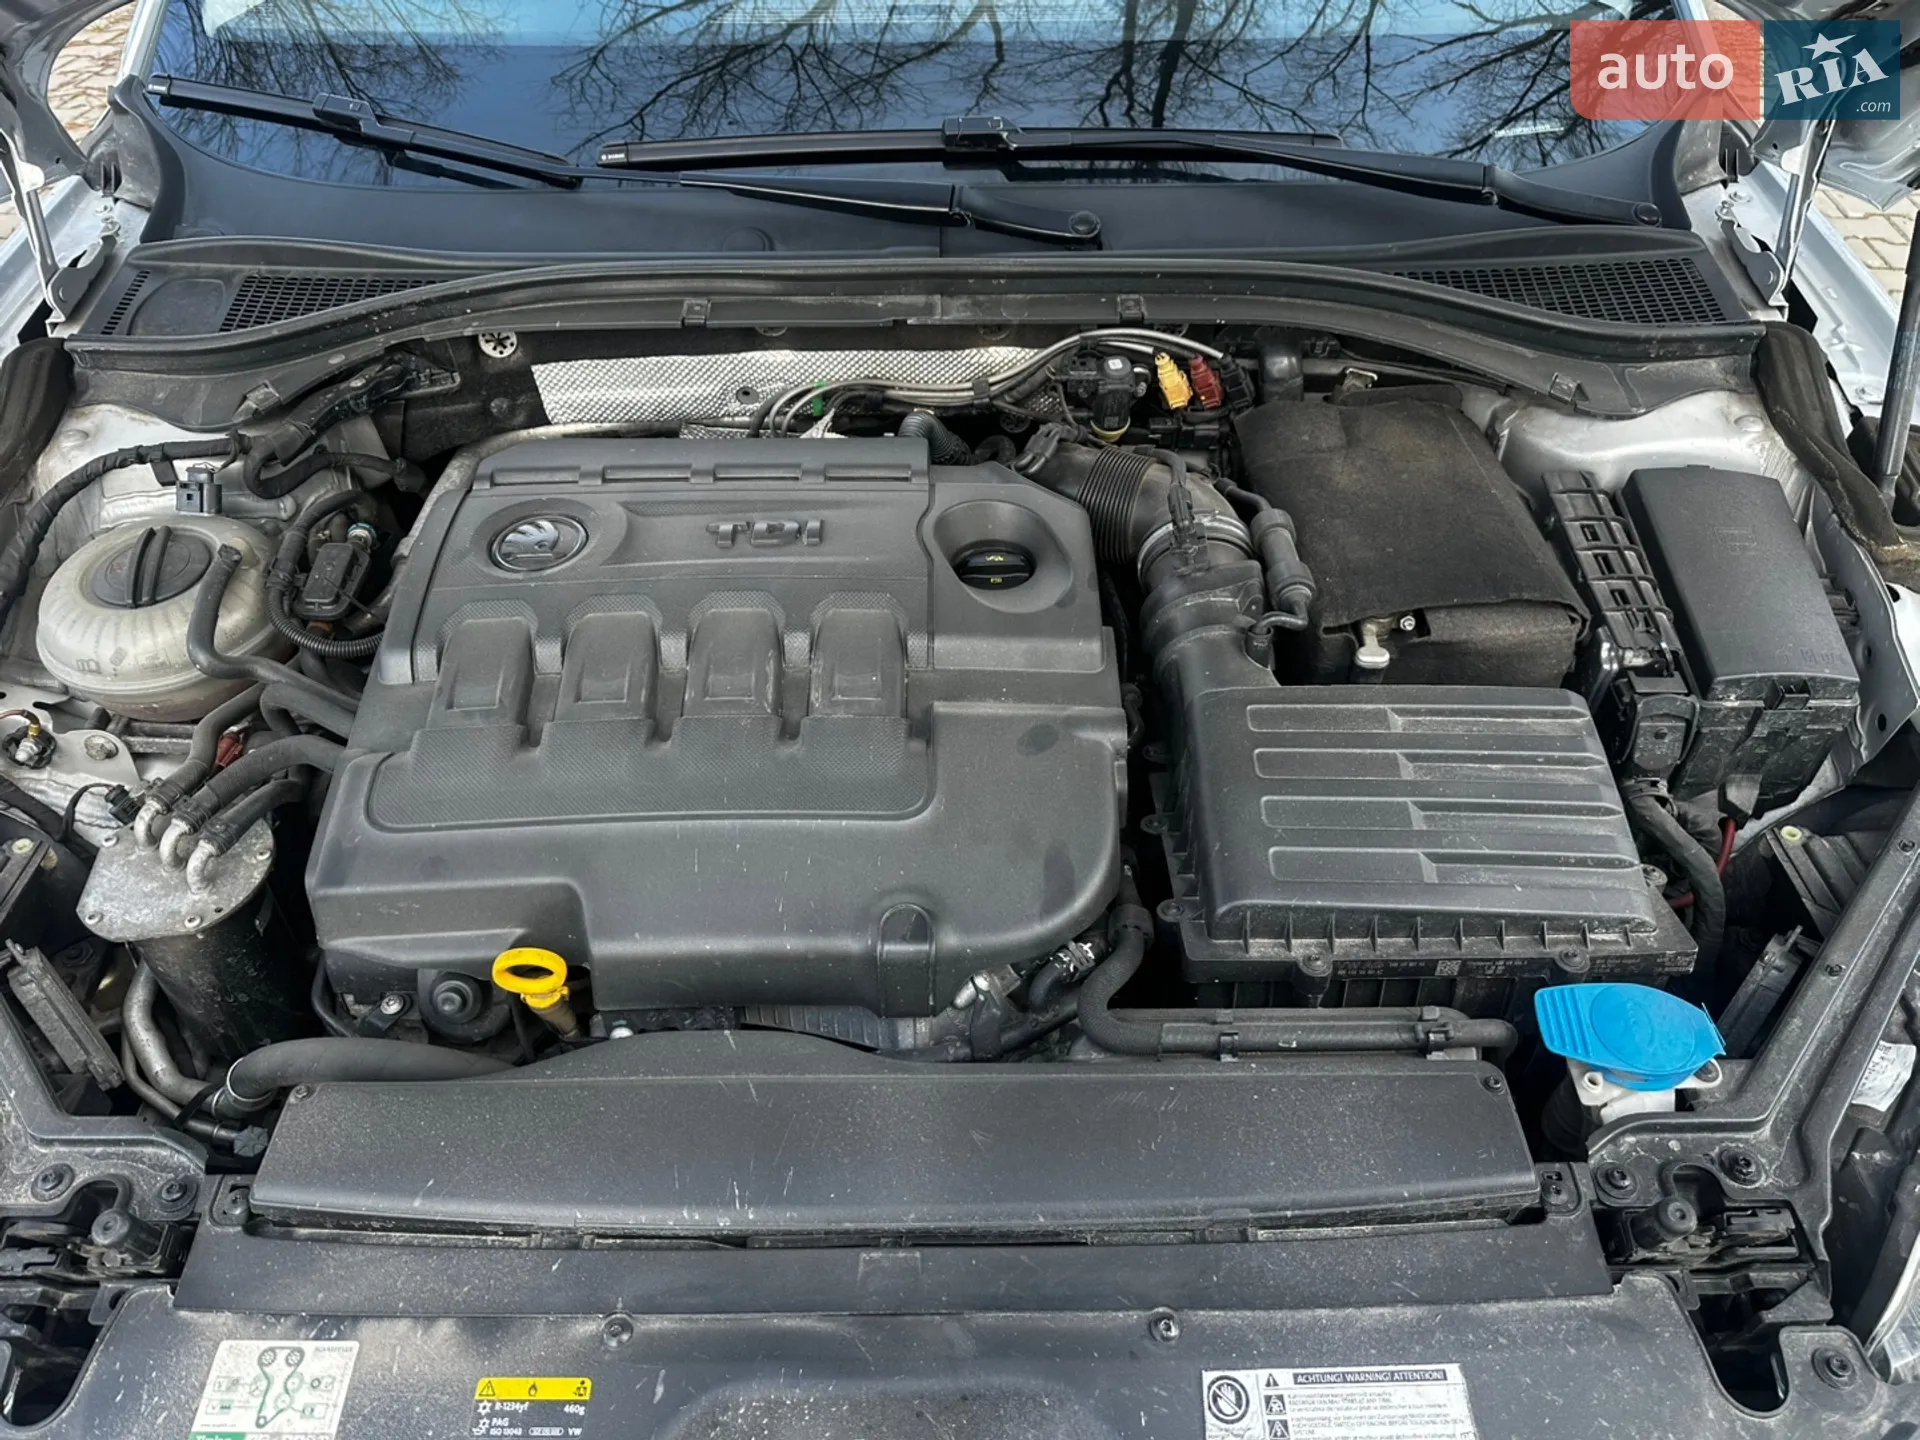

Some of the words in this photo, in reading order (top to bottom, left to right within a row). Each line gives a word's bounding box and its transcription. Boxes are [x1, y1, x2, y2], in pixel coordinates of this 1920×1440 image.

[706, 520, 822, 548] TDI
[1297, 1372, 1343, 1383] ACHTUNG!
[1346, 1371, 1391, 1382] WARNING!
[1393, 1370, 1444, 1381] ATTENTION!
